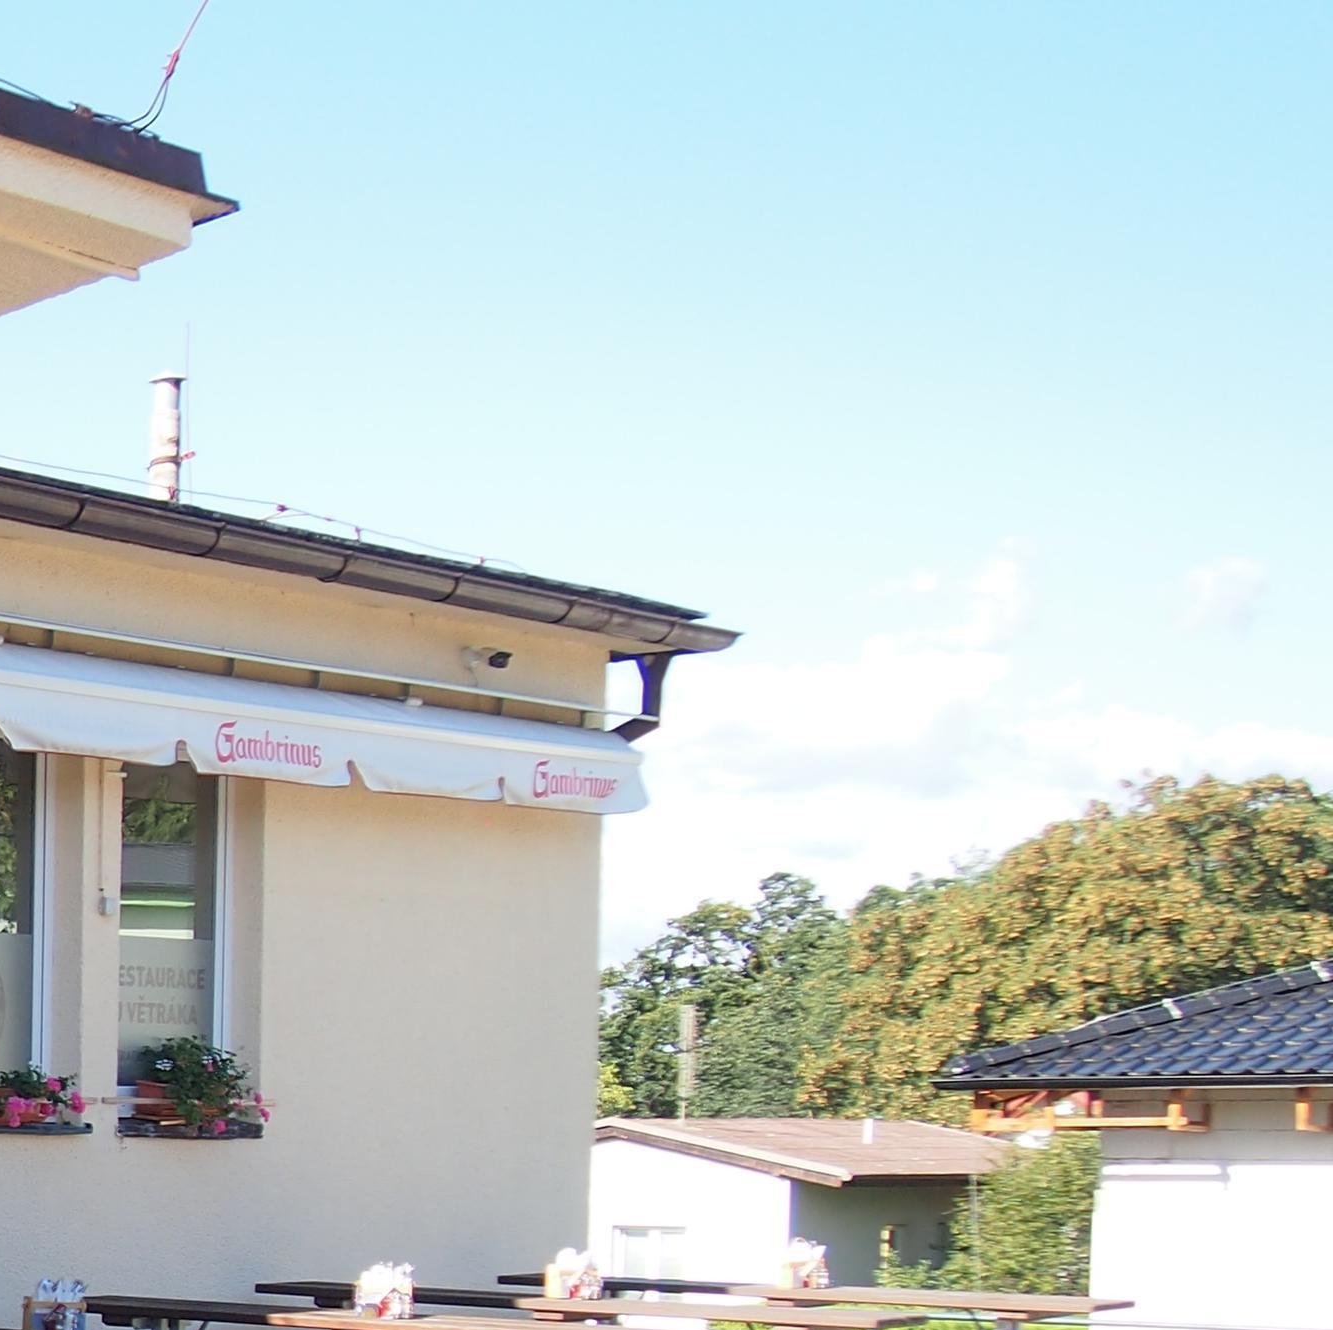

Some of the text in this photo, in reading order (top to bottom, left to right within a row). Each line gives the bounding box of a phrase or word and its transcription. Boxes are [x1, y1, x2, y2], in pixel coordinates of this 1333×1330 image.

[214, 720, 324, 770] Gambrinus
[533, 758, 620, 800] Gambrinus
[119, 965, 206, 990] ESTAURACE
